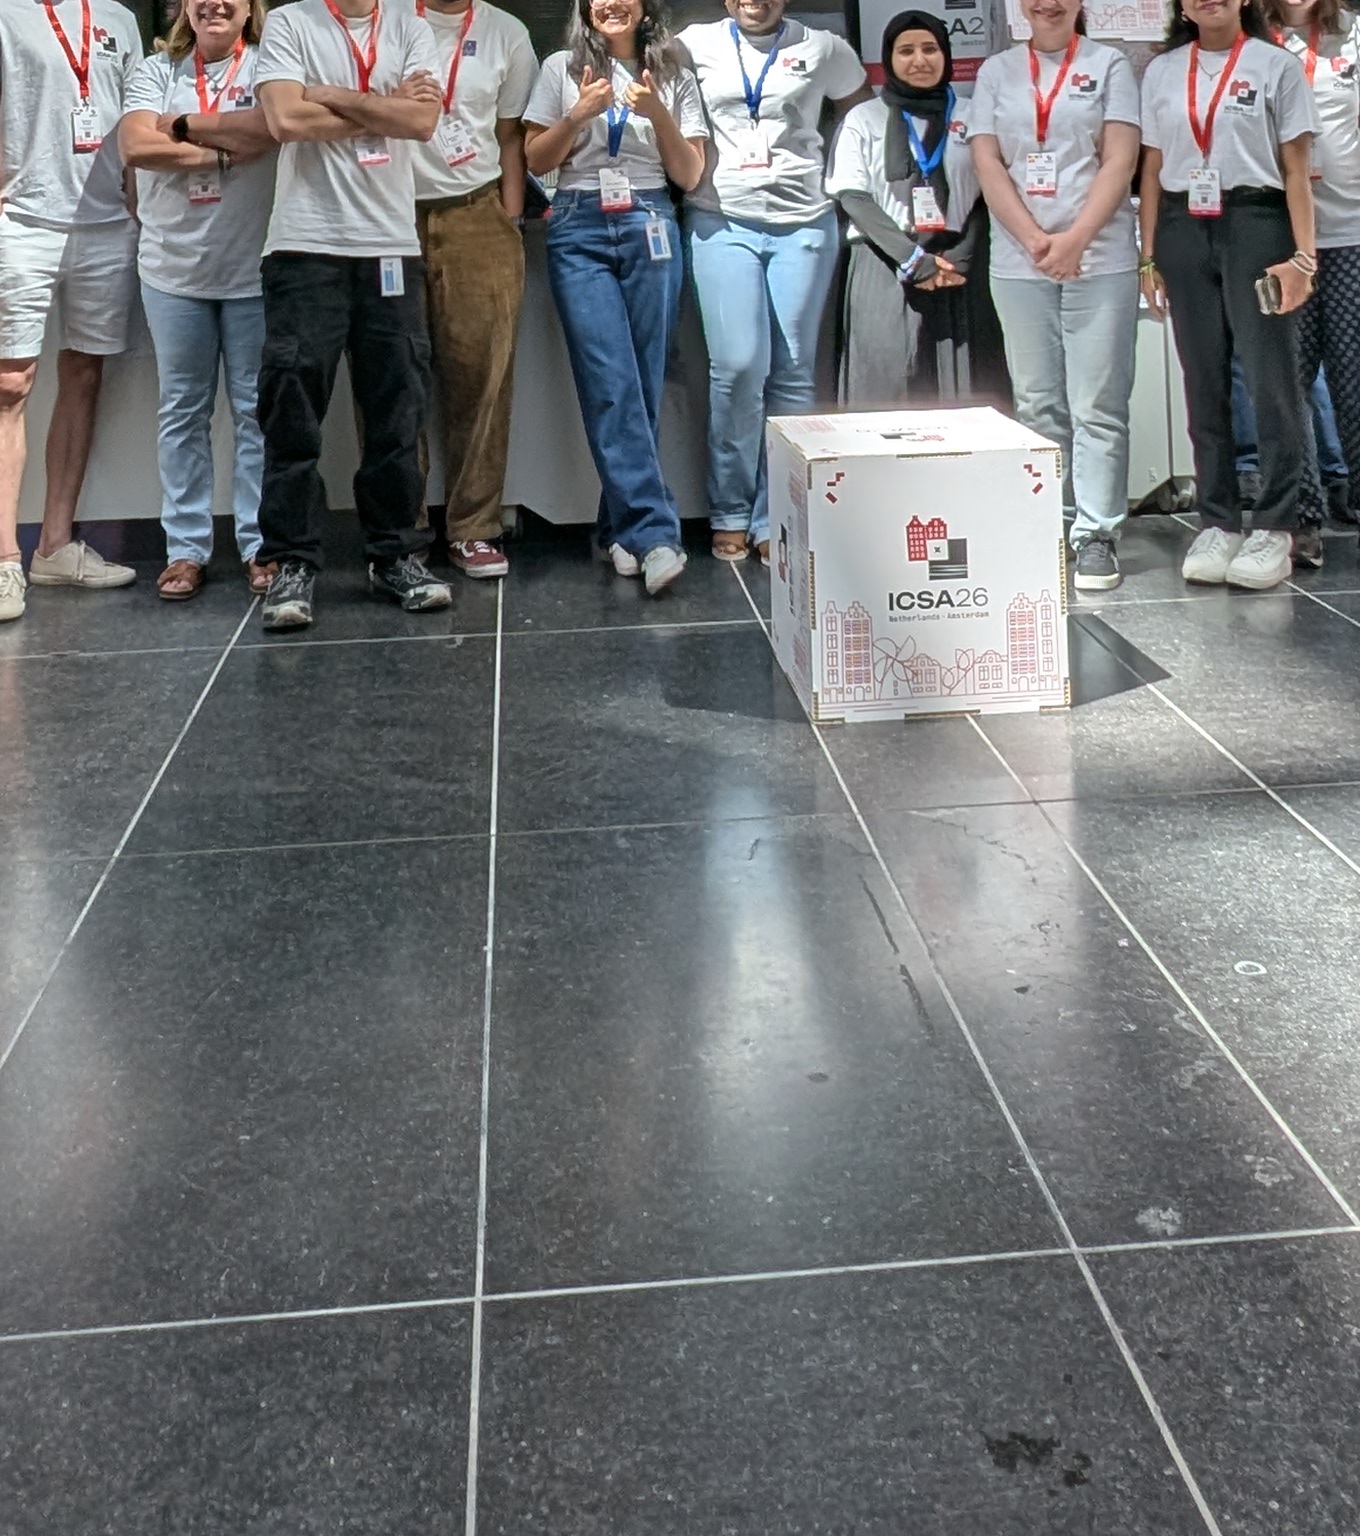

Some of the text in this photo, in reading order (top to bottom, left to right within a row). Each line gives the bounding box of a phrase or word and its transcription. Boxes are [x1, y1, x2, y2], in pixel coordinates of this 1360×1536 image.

[888, 587, 989, 611] ICSA26
[888, 611, 990, 623] Netherlands Amsterdam
